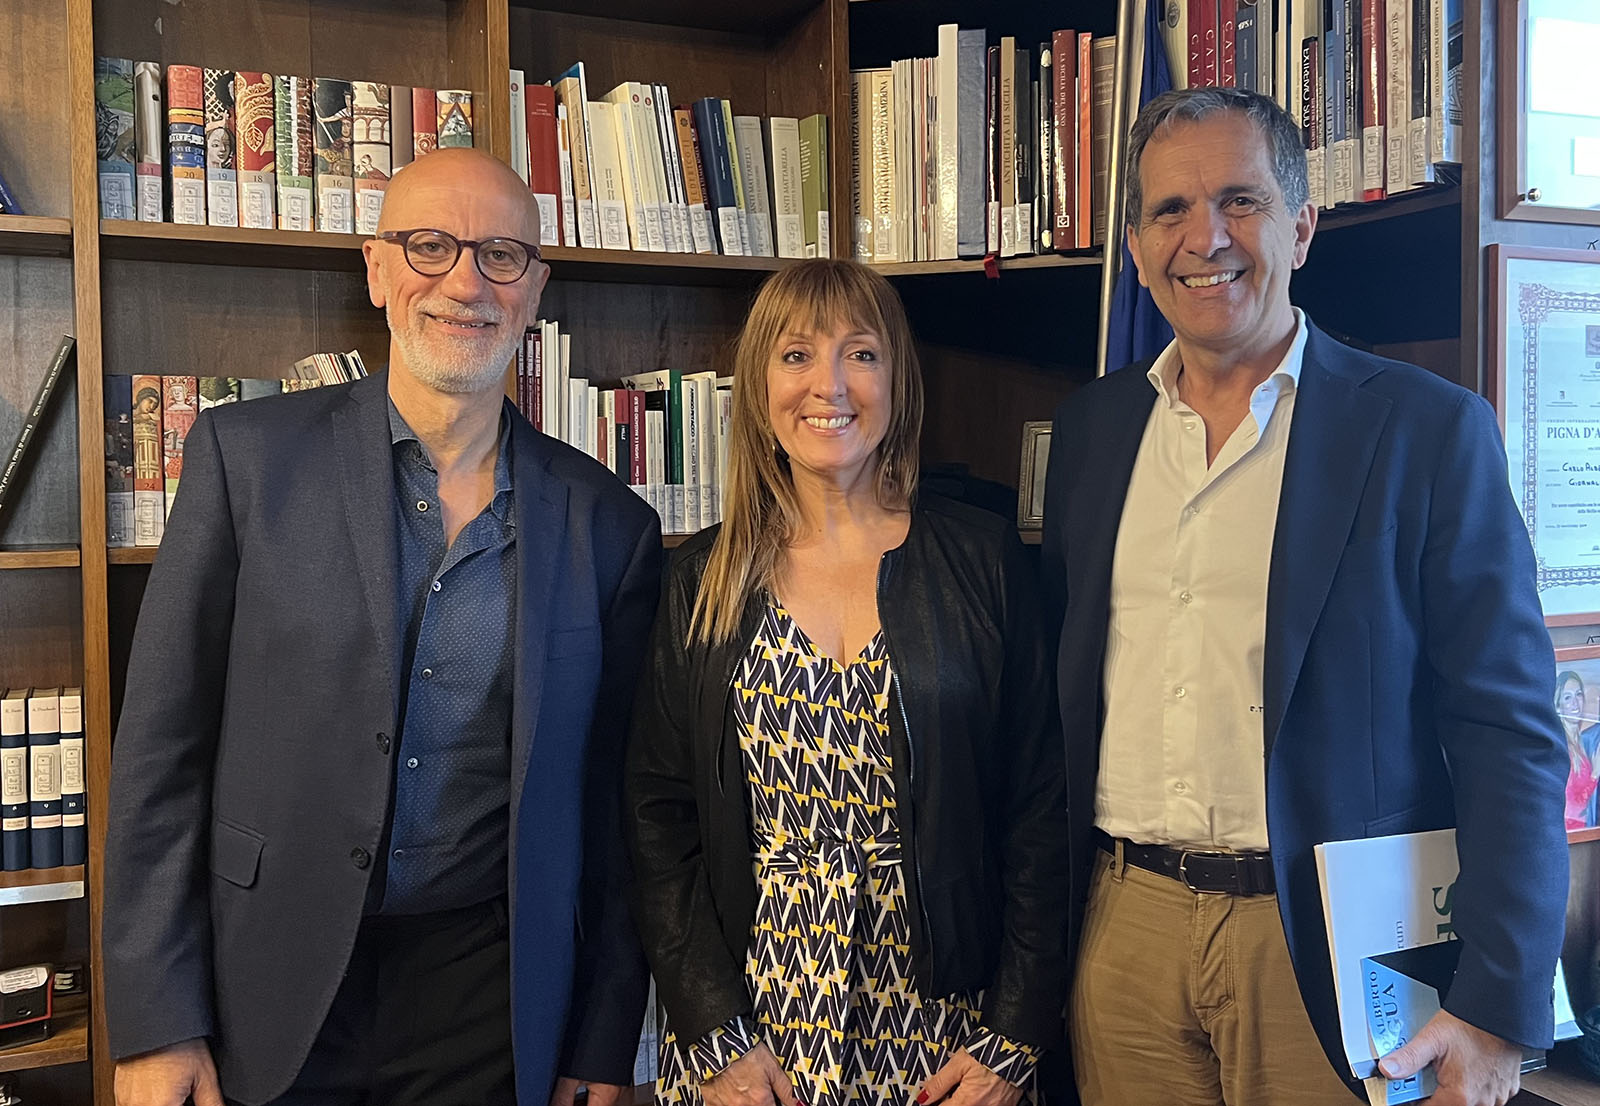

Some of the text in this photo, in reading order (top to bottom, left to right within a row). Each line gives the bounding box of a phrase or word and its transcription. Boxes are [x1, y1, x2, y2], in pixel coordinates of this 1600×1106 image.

[1060, 53, 1066, 62] LA
[1206, 30, 1214, 86] CATA
[851, 82, 859, 120] ARMERINA
[880, 81, 888, 118] ARMERINA
[1004, 115, 1010, 124] DI
[744, 145, 756, 193] MATTARELLA
[781, 147, 790, 194] MATTARELLA
[852, 148, 859, 156] DI
[684, 152, 700, 202] FEDERICO
[853, 180, 860, 188] LA
[1547, 427, 1600, 438] PIGNA D'A
[1396, 920, 1404, 948] rum
[1369, 971, 1386, 1035] ALBERTO
